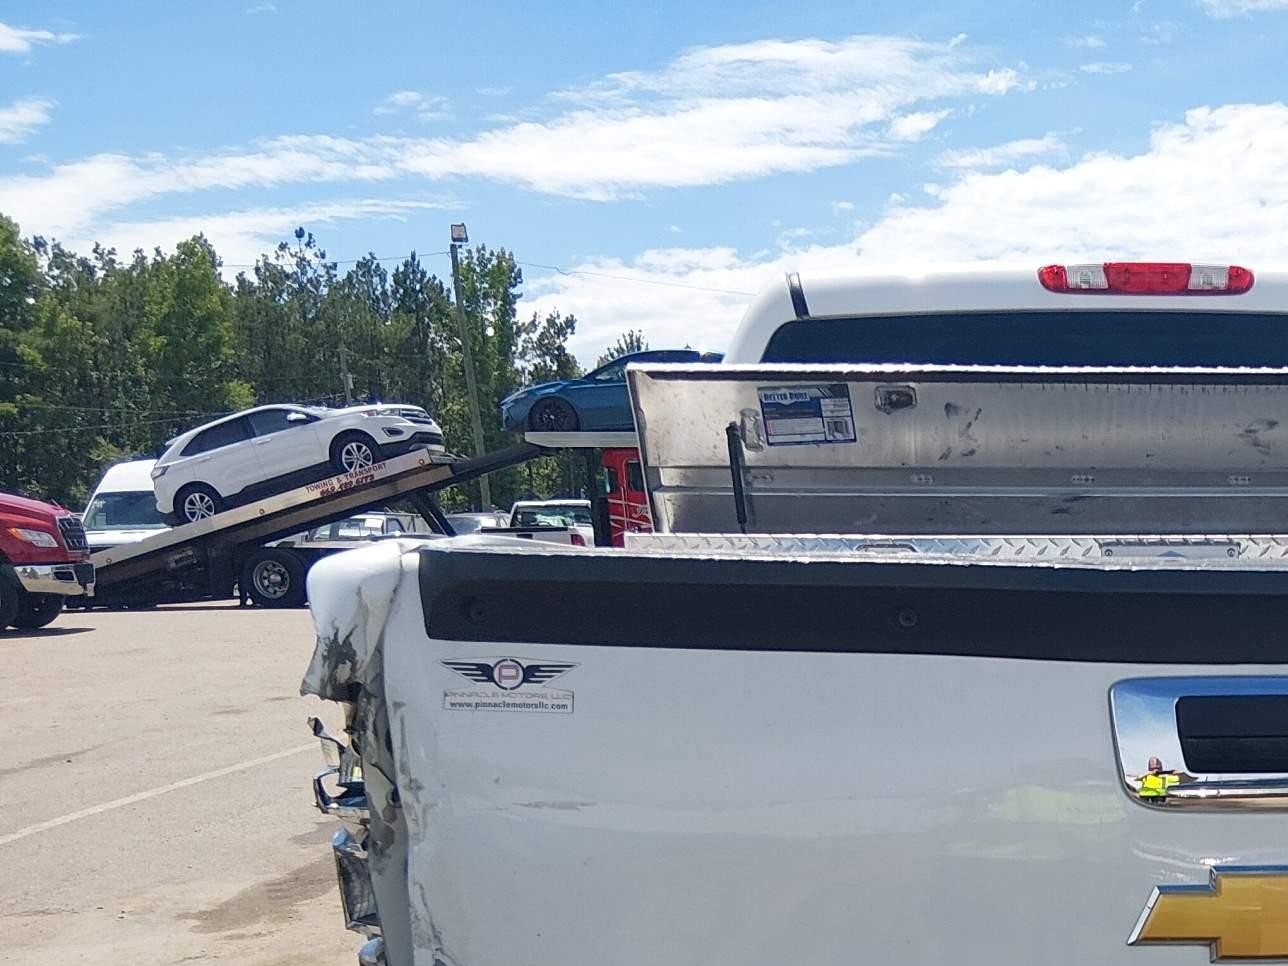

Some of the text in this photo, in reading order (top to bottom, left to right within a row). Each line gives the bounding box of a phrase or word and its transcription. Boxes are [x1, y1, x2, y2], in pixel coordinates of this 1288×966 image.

[305, 479, 333, 493] TOWING
[343, 463, 387, 480] TRANSPORT
[446, 691, 499, 699] PINNACLE
[501, 692, 548, 700] MOTORS
[449, 700, 568, 711] www.pinnaclemotorsllc.com
